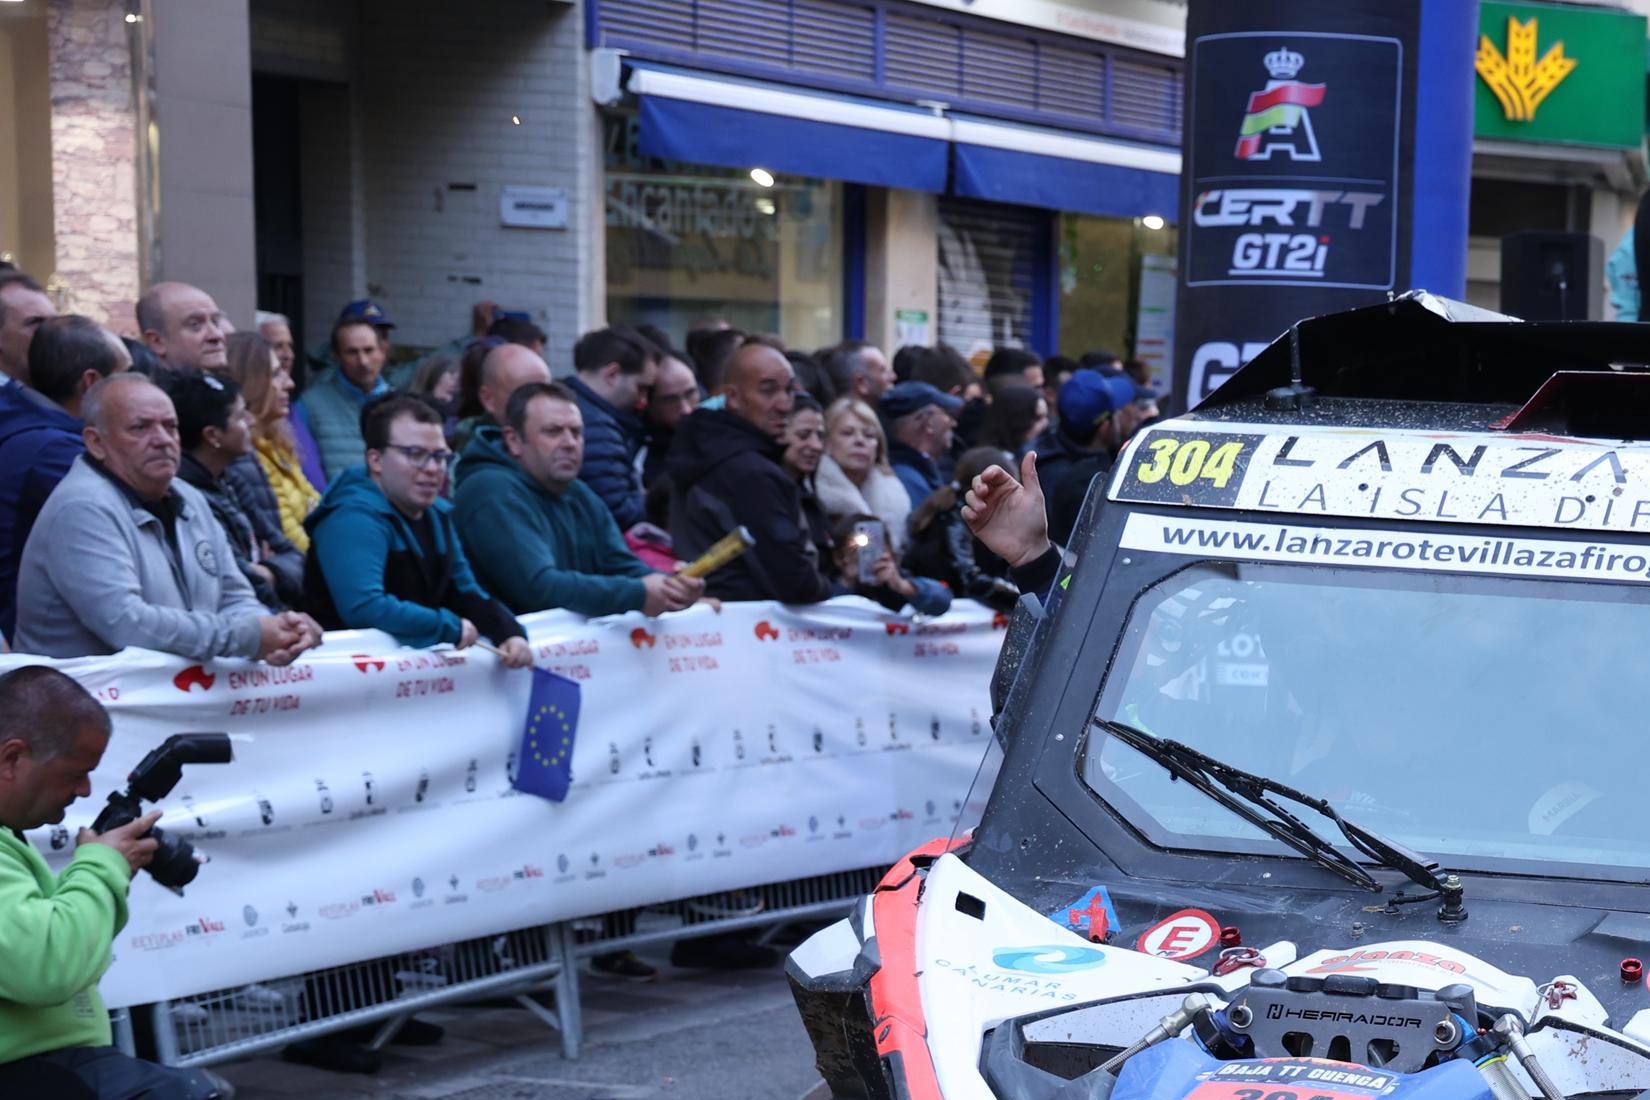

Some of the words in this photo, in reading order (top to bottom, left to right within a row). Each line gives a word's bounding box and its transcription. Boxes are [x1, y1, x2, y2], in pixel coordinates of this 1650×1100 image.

[1233, 233, 1331, 272] GT2i
[1138, 438, 1245, 488] 304
[1258, 480, 1327, 511] LA
[1370, 486, 1509, 520] ISLA
[1157, 926, 1201, 952] E
[935, 958, 1077, 1001] CANARIAS
[968, 965, 1062, 990] LUMAR
[1220, 1064, 1271, 1076] BAJA
[1278, 1064, 1307, 1077] TT
[1307, 1068, 1389, 1090] CUENCA
